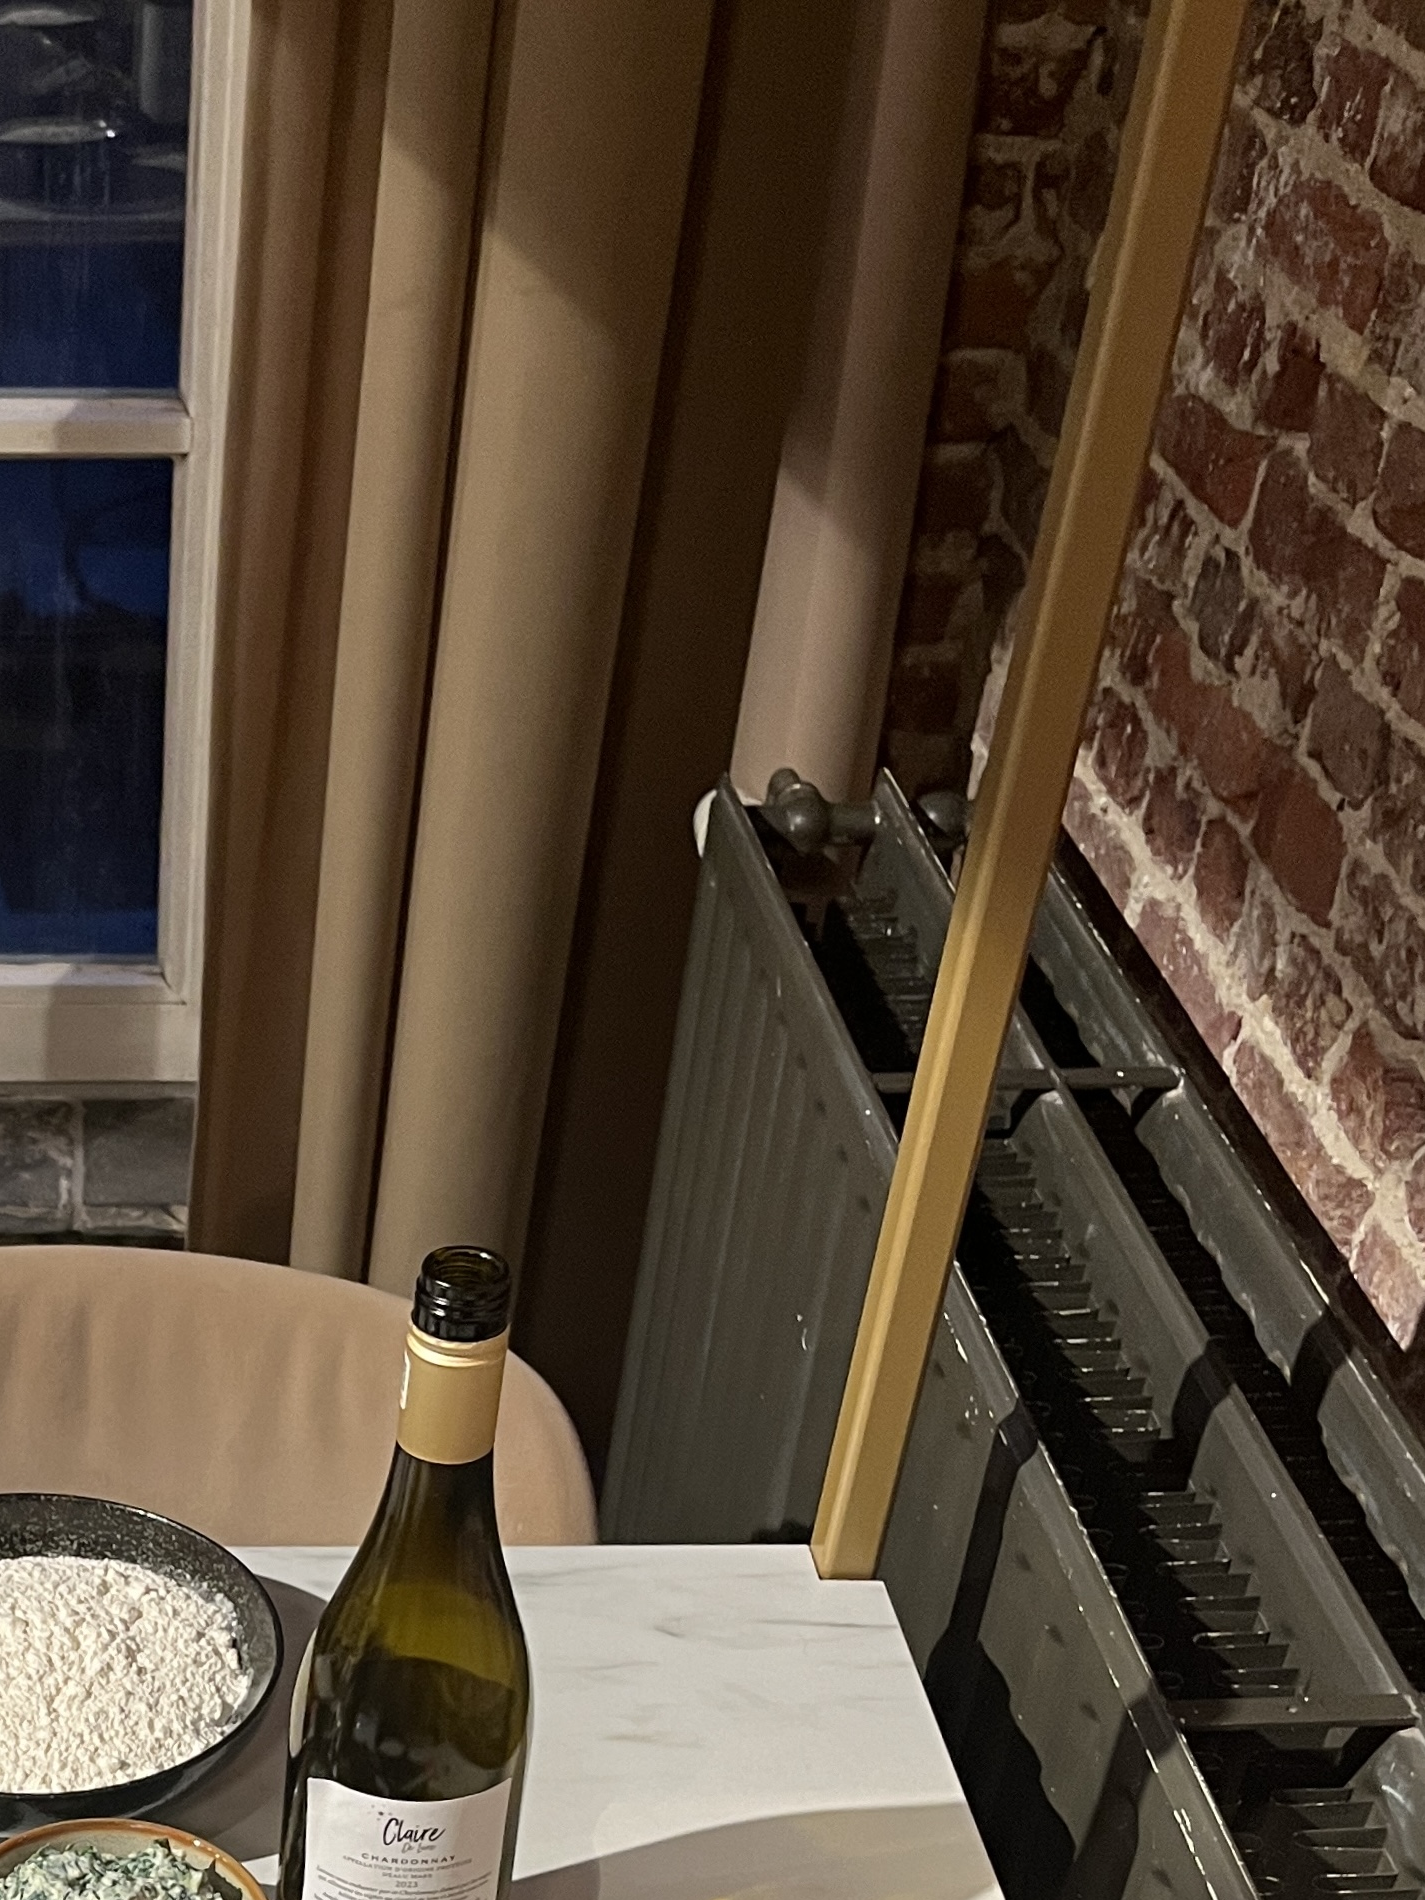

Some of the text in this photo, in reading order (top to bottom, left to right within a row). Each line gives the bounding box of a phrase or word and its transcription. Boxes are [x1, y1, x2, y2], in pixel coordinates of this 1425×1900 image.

[382, 1817, 446, 1846] Claire
[361, 1852, 456, 1865] CHARDONNAY
[395, 1880, 419, 1889] 2023
